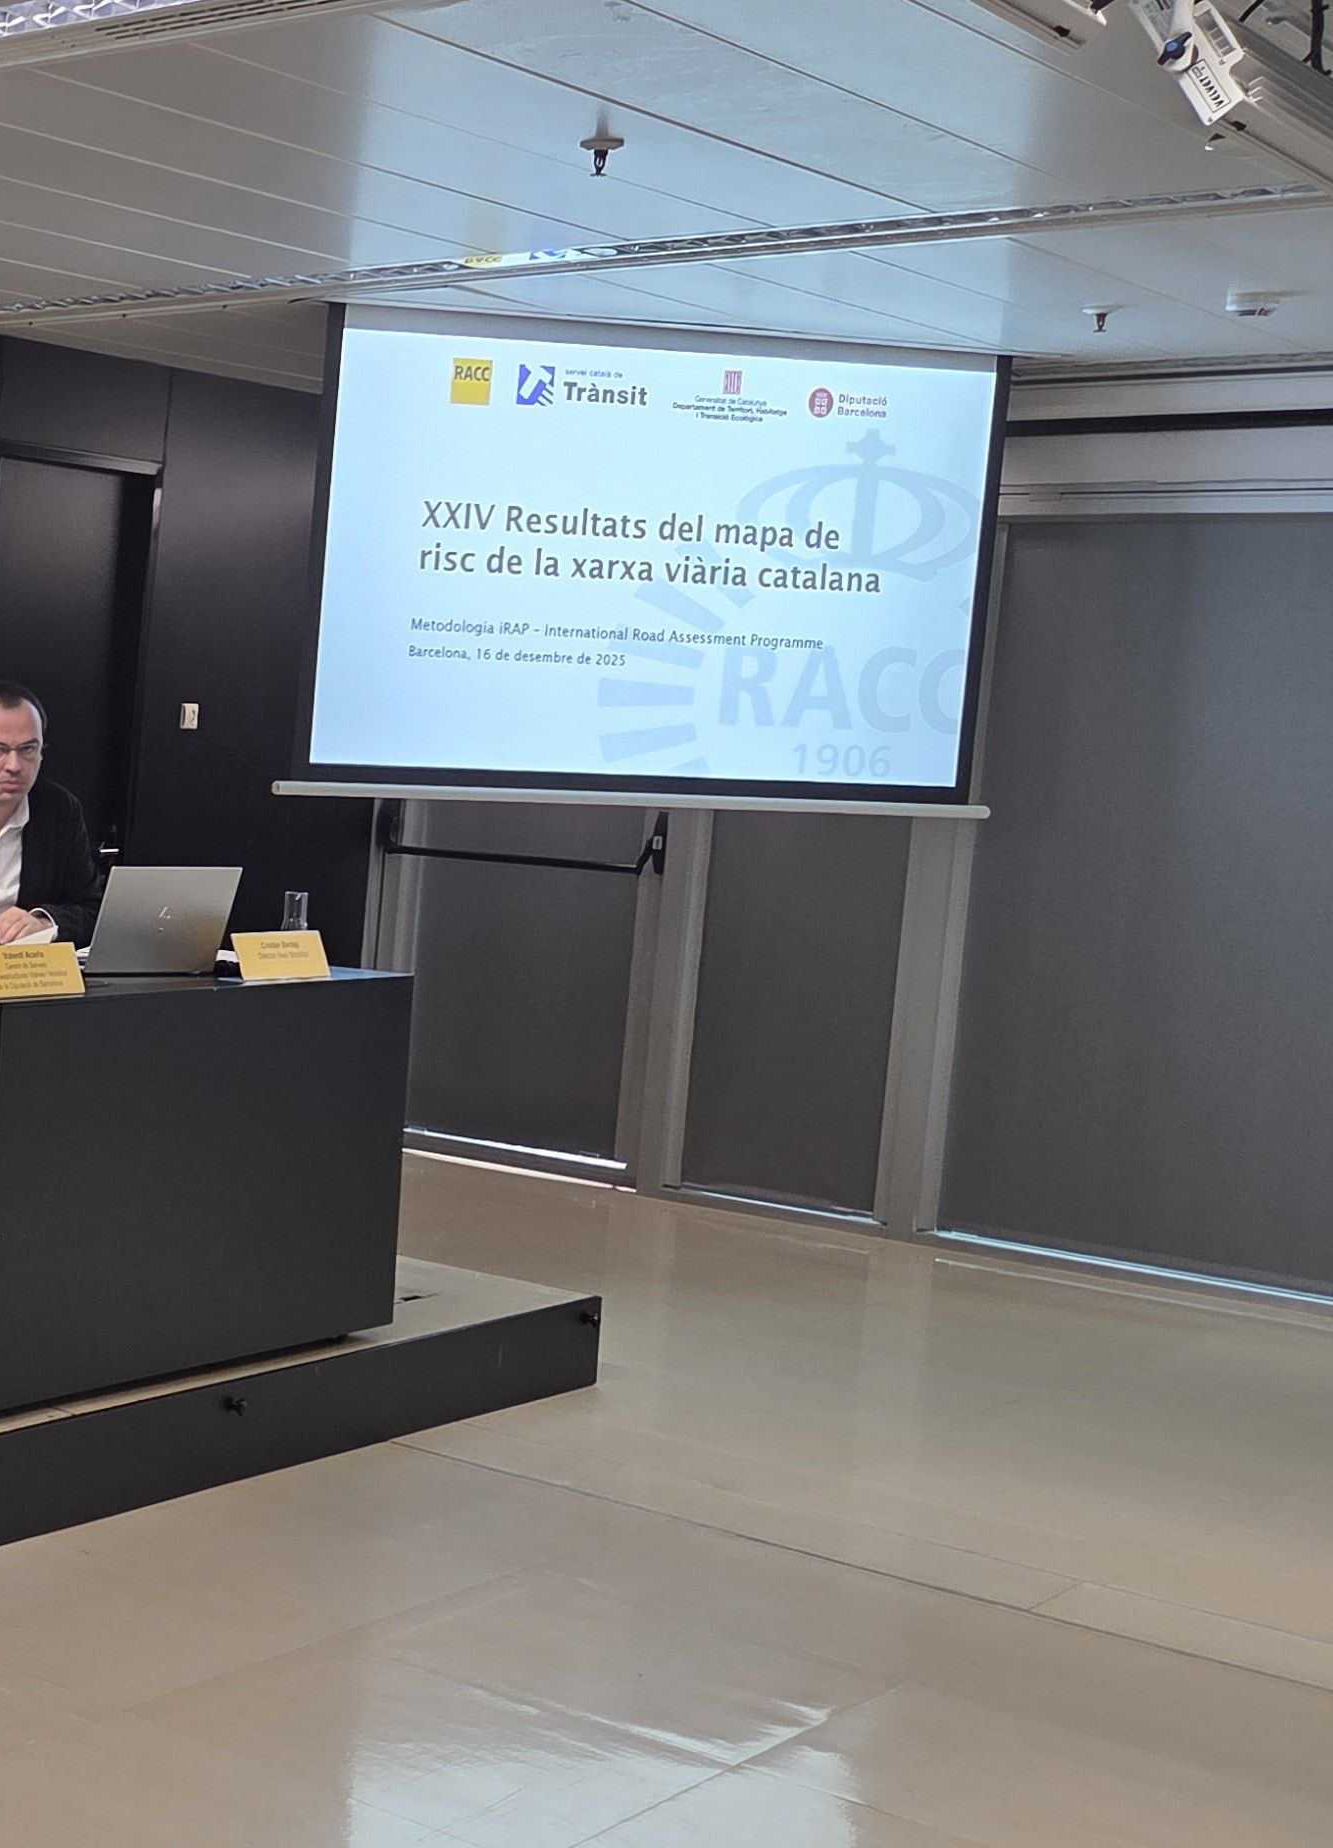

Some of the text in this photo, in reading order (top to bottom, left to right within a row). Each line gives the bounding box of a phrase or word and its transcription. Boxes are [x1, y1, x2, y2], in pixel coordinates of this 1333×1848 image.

[454, 365, 491, 382] RACC
[563, 381, 647, 406] Trànsit
[839, 393, 888, 406] Diputació
[838, 406, 886, 418] Barcelona
[421, 500, 840, 552] XXIV Resultats del mapa de
[420, 542, 881, 593] risc de la xarxa viària catalana
[410, 618, 494, 636] Metodologia
[499, 622, 530, 635] iRAP
[545, 624, 628, 641] International
[633, 628, 665, 642] Road
[668, 630, 746, 646] Assessment
[750, 634, 824, 650] Programme
[408, 645, 626, 666] Barcelona, 16 de desembre de 2025
[793, 743, 892, 777] 1906
